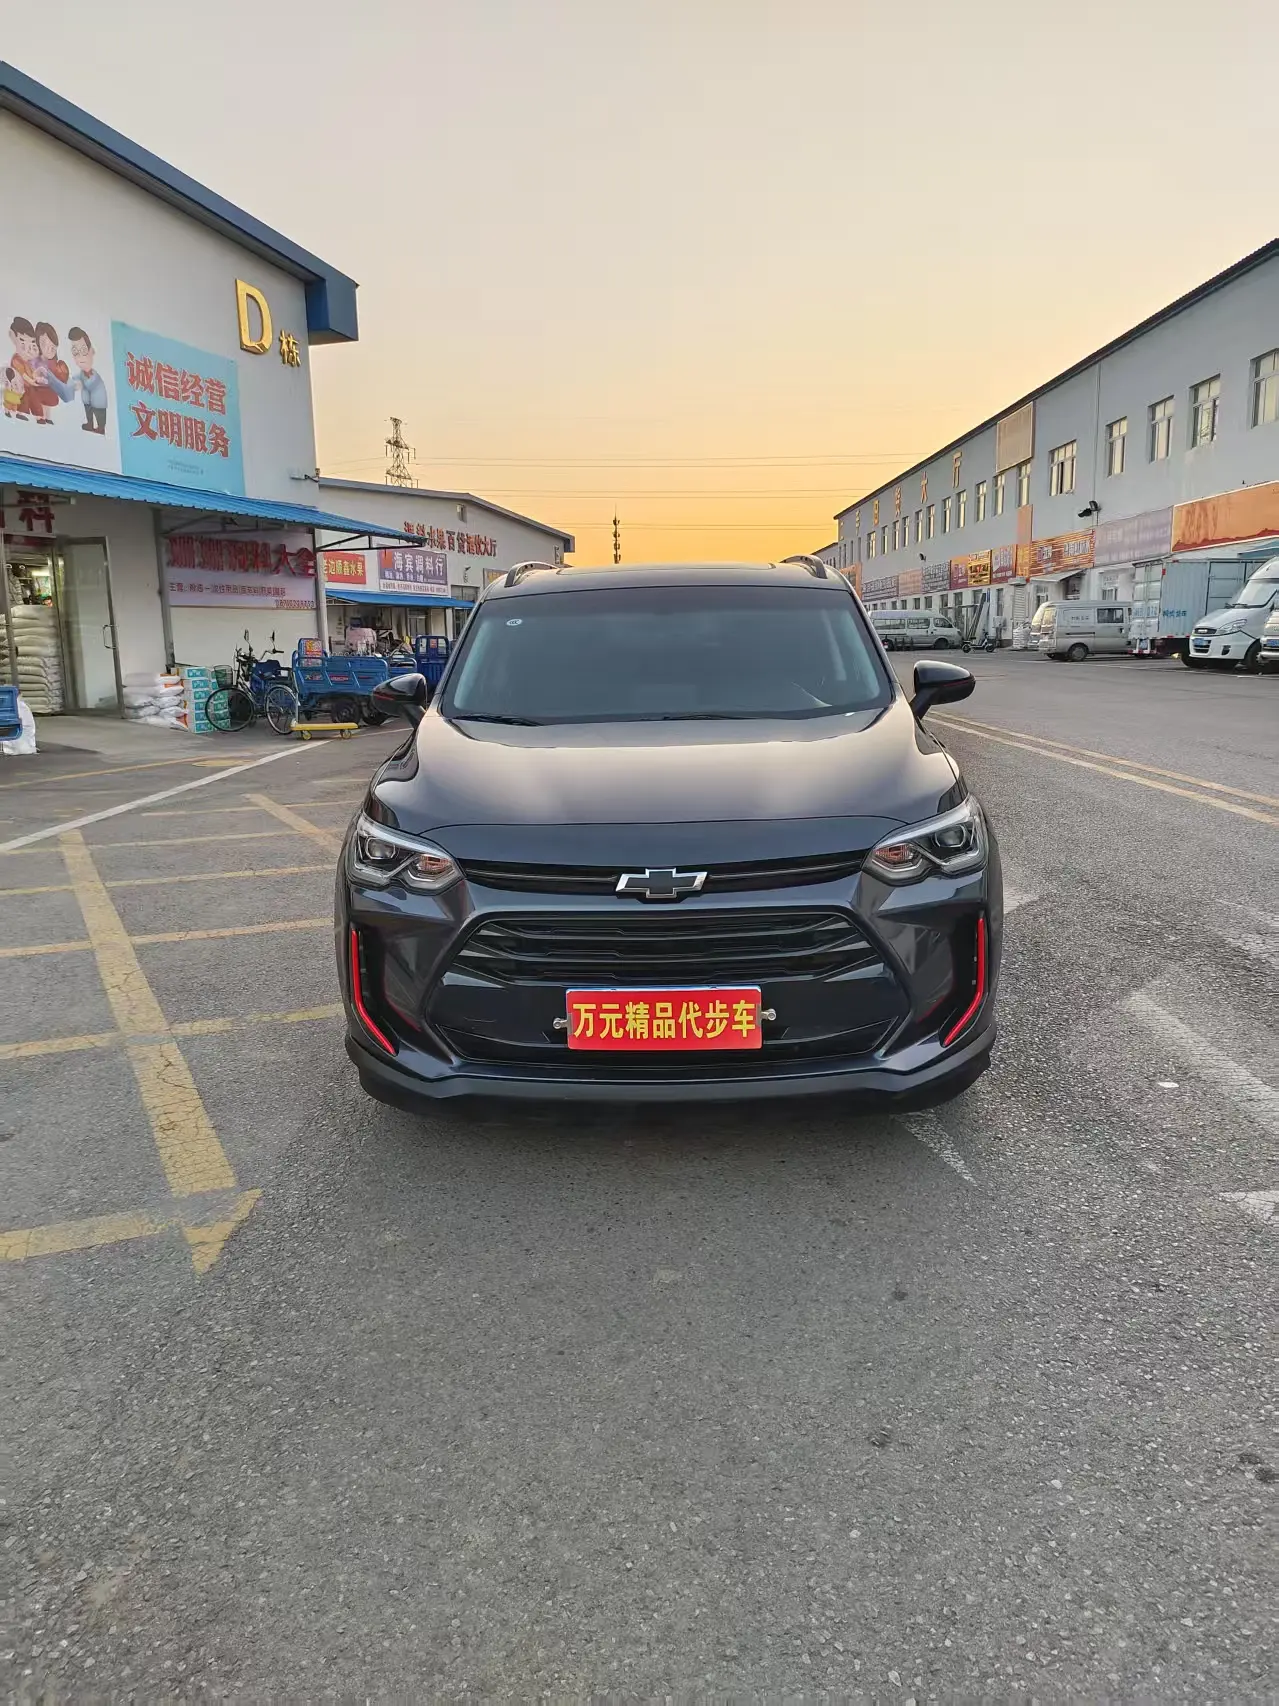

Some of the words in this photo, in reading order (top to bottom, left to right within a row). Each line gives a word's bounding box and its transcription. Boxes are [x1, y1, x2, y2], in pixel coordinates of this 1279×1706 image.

[234, 278, 273, 355] D
[279, 329, 301, 367] 栋
[126, 351, 227, 416] 诚信经营
[131, 400, 231, 458] 文明服务
[572, 999, 756, 1039] 万元精品代步车
